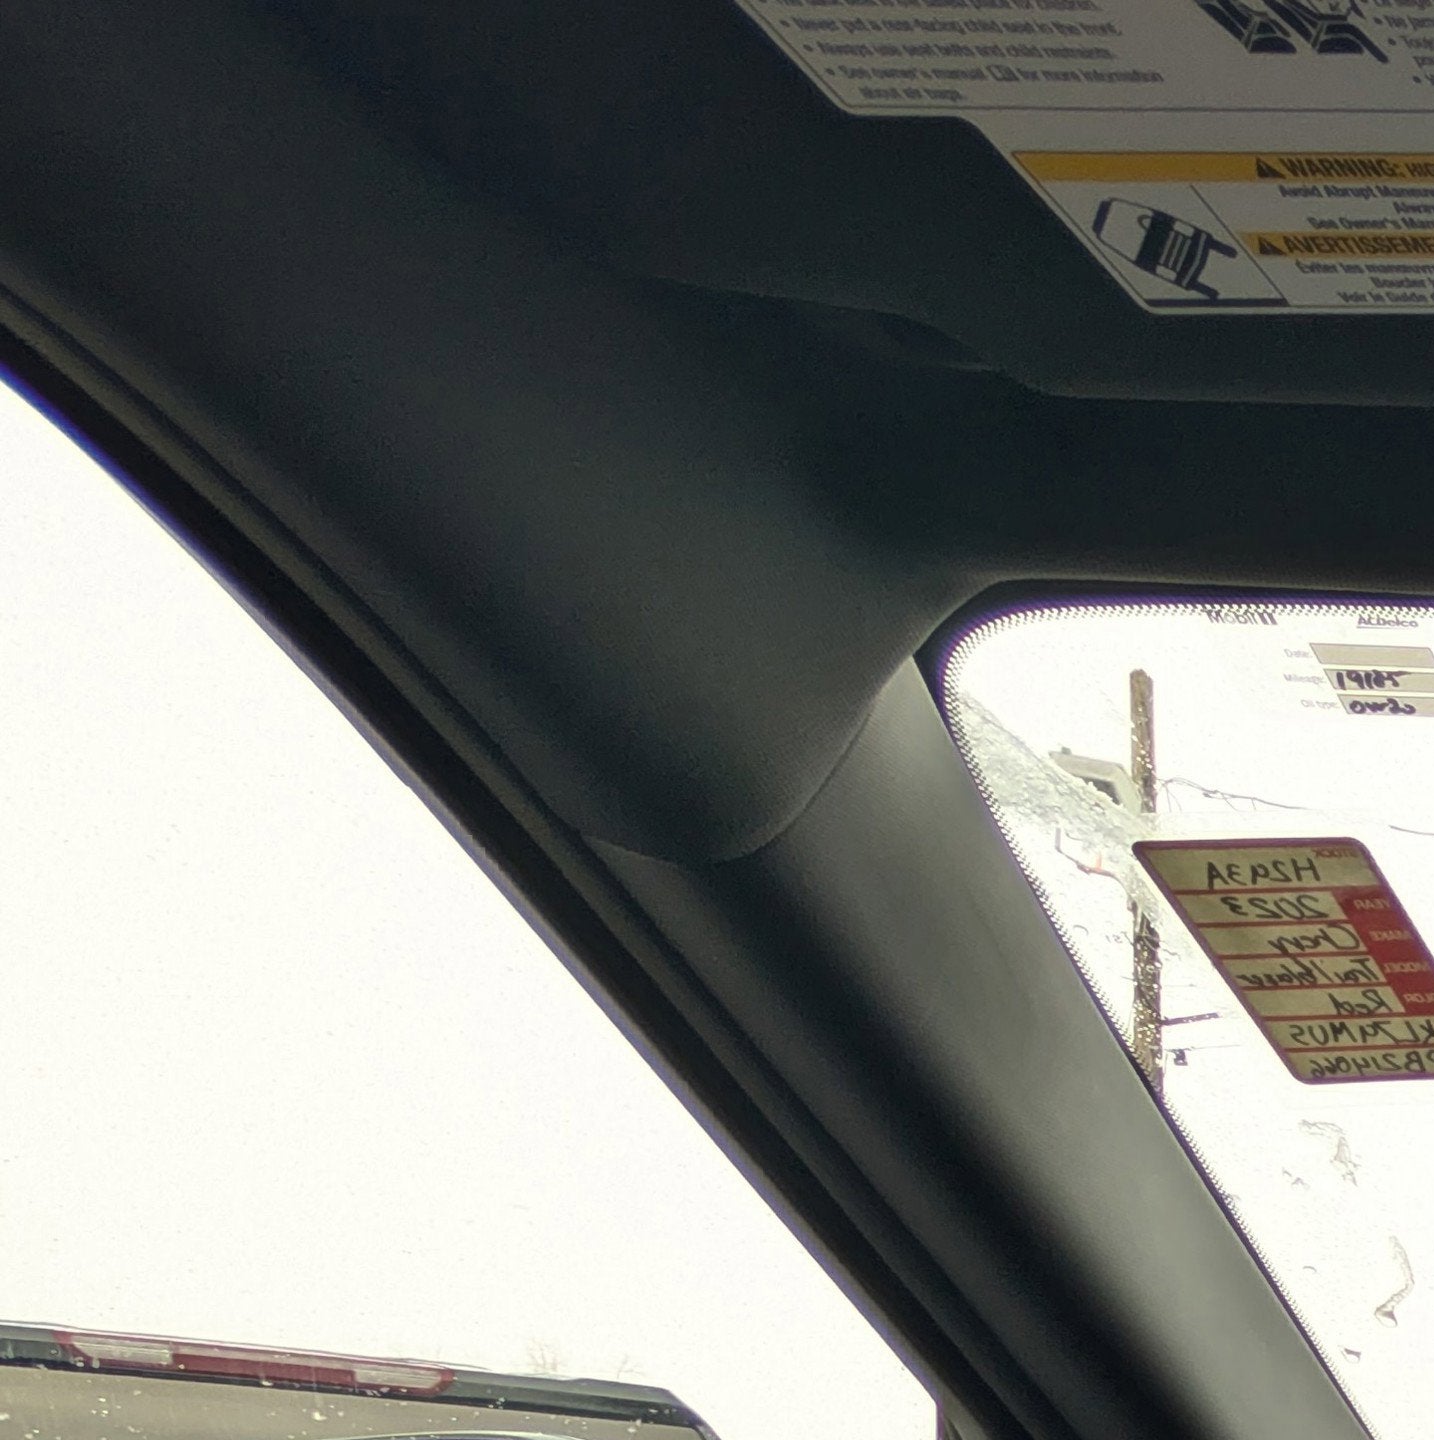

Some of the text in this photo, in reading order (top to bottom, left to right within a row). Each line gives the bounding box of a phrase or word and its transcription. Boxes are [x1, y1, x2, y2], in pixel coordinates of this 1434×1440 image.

[1281, 157, 1404, 178] WARNING:
[1278, 185, 1322, 198] Avoid
[1323, 185, 1376, 200] Abrupt
[1307, 216, 1339, 230] See
[1338, 216, 1401, 230] Owner's
